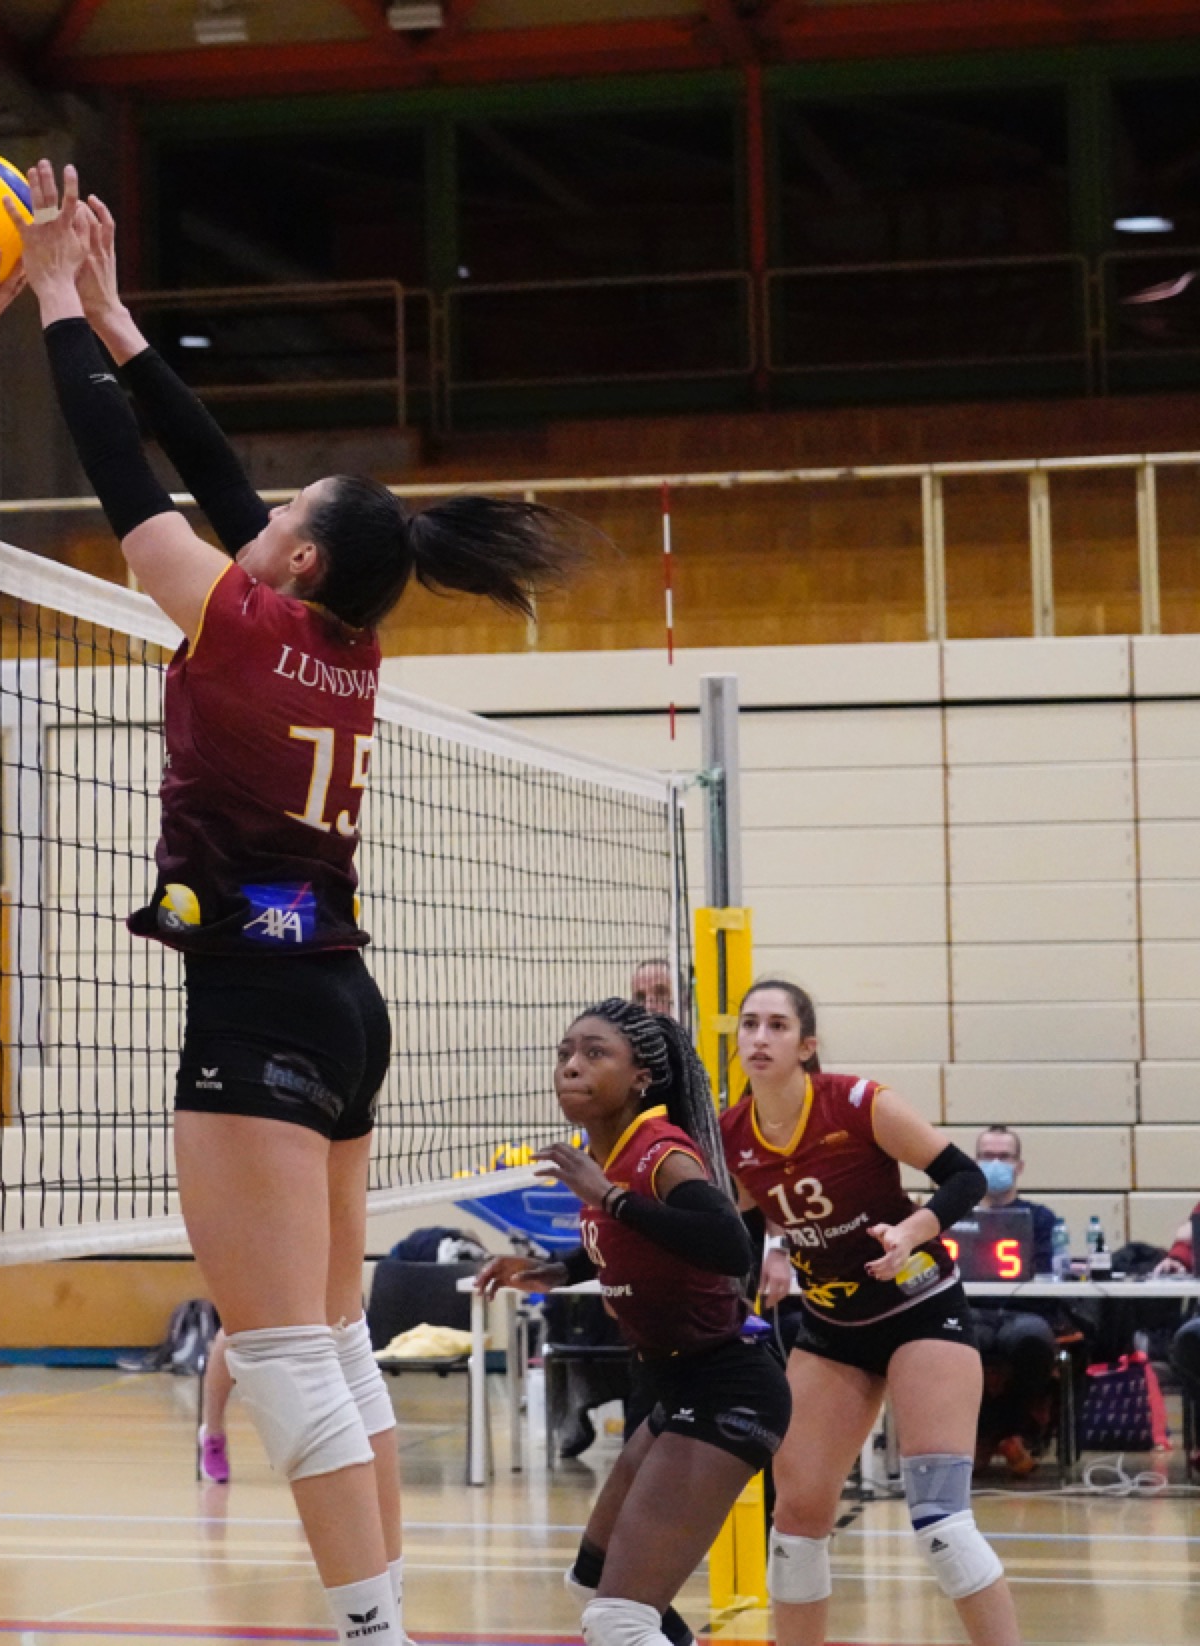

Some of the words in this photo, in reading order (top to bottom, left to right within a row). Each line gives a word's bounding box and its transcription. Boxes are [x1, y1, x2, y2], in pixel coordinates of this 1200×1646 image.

[243, 907, 303, 942] AXA
[767, 1177, 834, 1226] 13
[996, 1238, 1022, 1278] 5
[346, 1622, 389, 1638] erima
